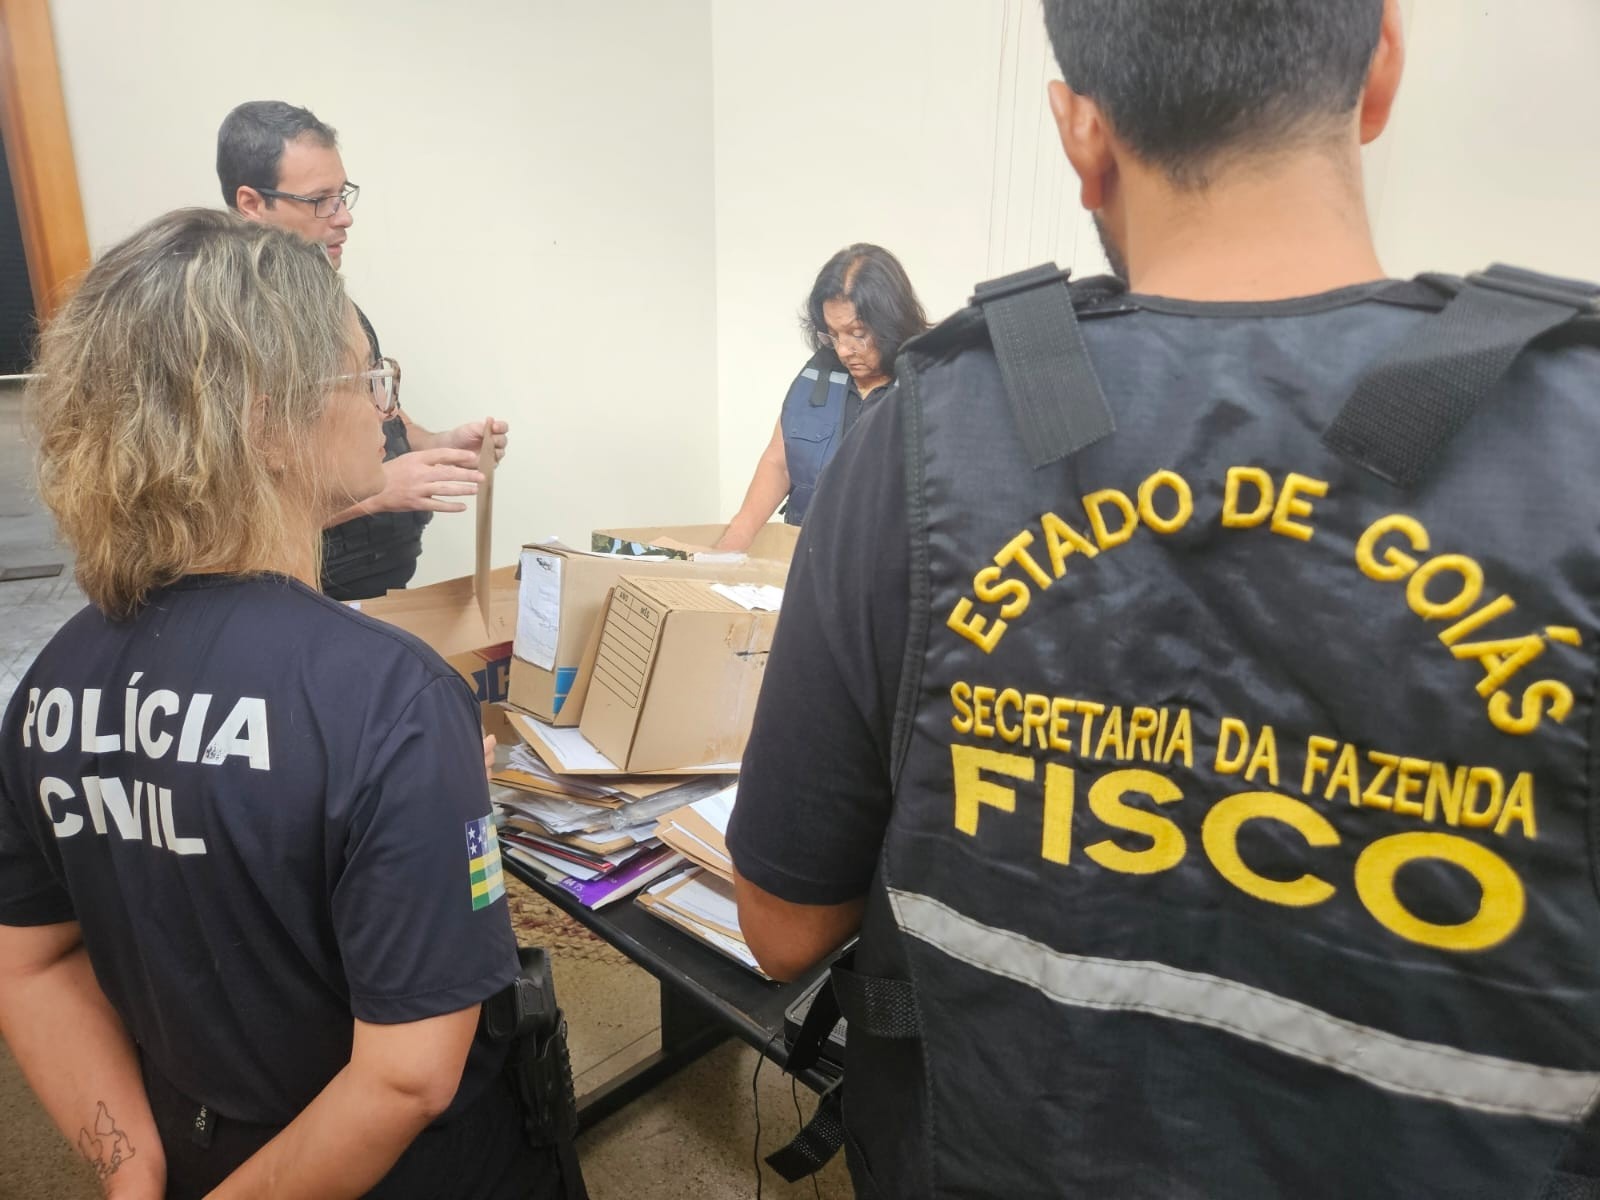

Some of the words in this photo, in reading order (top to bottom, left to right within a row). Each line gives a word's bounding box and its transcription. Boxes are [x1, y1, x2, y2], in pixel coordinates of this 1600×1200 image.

[946, 468, 1193, 654] ESTADO
[1221, 465, 1329, 542] DE
[1354, 514, 1583, 735] GOIÁS
[22, 671, 271, 771] POLÍCIA
[950, 680, 1194, 768] SECRETARIA
[1213, 716, 1280, 786] DA
[1301, 735, 1538, 839] FAZENDA
[39, 775, 207, 856] CIVIL
[950, 743, 1526, 952] FISCO
